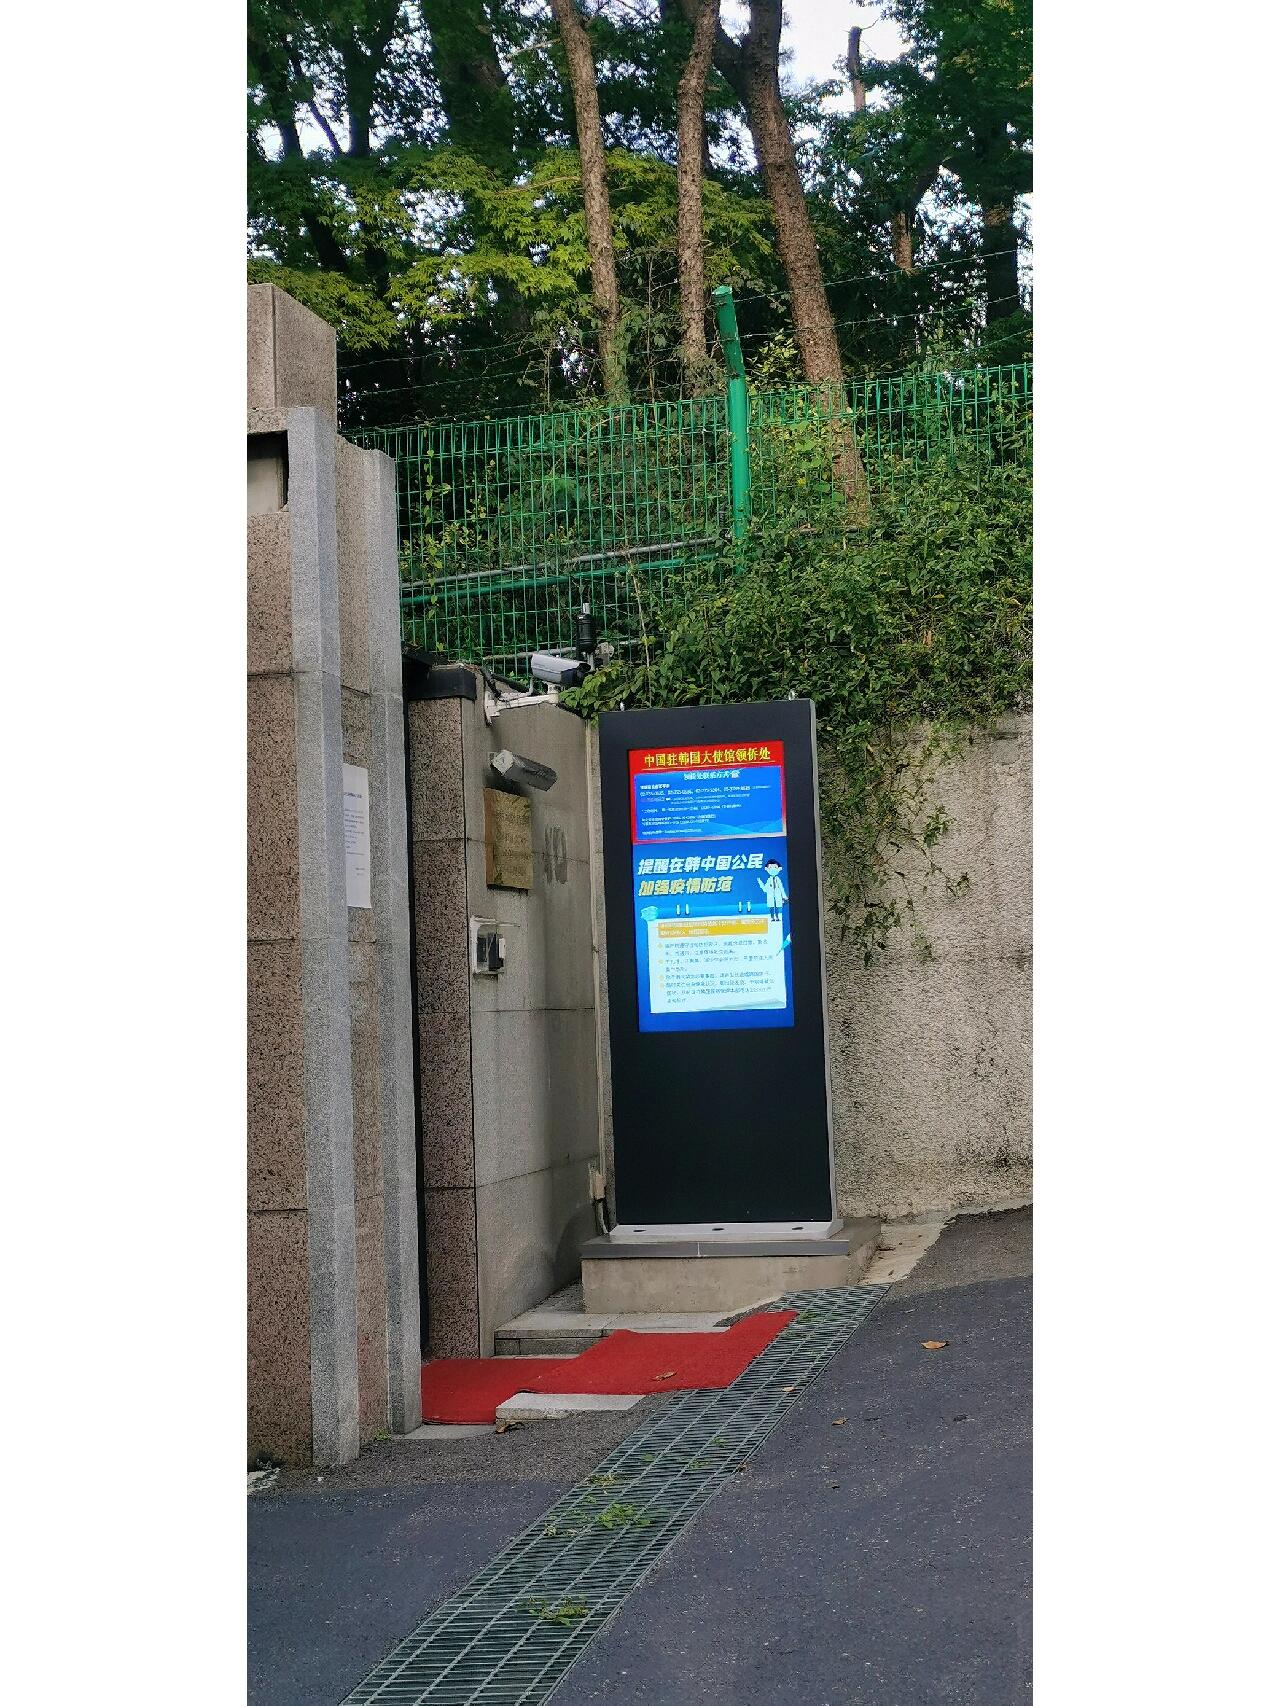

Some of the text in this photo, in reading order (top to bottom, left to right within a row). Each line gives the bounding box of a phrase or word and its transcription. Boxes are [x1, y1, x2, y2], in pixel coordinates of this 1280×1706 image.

[644, 747, 770, 767] 中国驻韩国大使馆领侨处
[638, 853, 763, 875] 提醒在韩中国公民
[638, 876, 733, 896] 加强疫情防范
